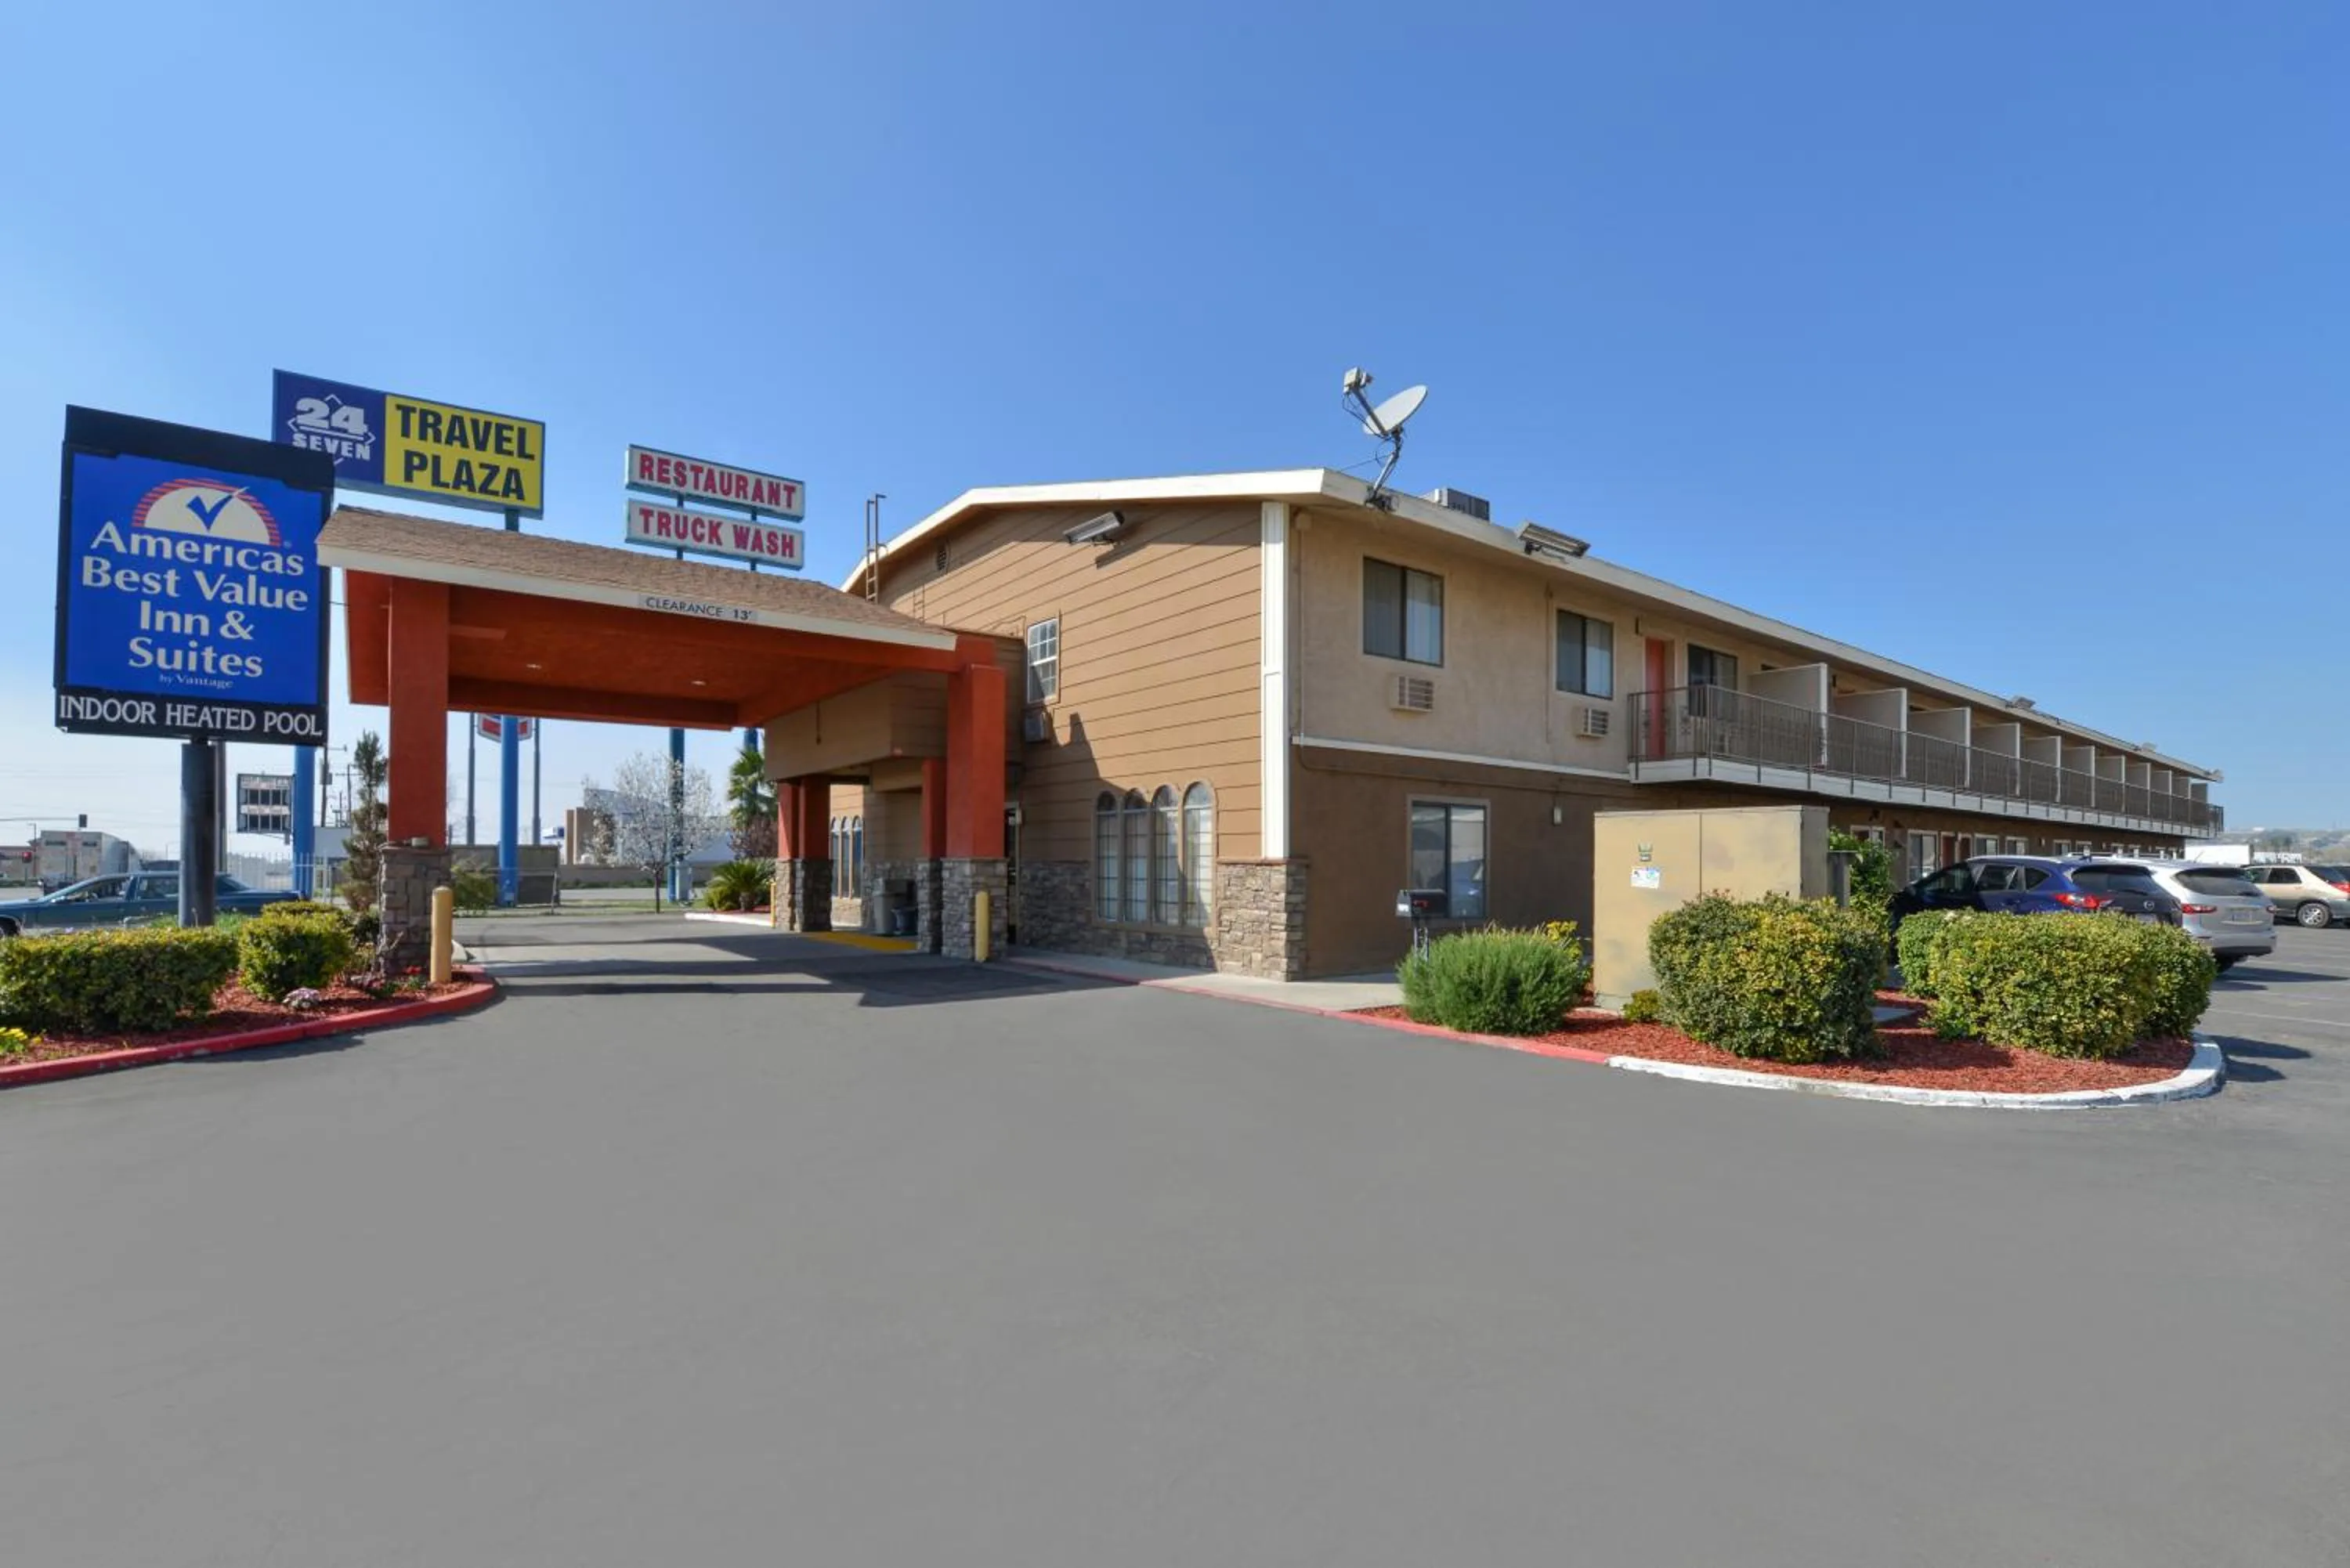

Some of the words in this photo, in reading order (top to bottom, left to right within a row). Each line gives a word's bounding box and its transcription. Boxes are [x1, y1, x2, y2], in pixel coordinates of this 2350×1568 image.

[295, 397, 368, 435] 24
[396, 403, 535, 461] TRAVEL
[292, 432, 371, 461] SEVEN
[403, 450, 525, 500] PLAZA
[639, 453, 796, 509] RESTAURANT
[90, 520, 304, 576] Americas
[639, 508, 723, 546] TRUCK
[732, 524, 794, 558] WASH
[82, 555, 181, 598] Best
[193, 569, 308, 611] Value
[140, 600, 210, 637] Inn
[219, 610, 255, 640] &
[645, 597, 724, 617] CLEARANCE
[128, 636, 263, 677] Suites
[159, 674, 172, 687] by
[175, 674, 233, 689] Vantage
[60, 695, 156, 724] INDOOR
[165, 703, 255, 731] HEATED
[263, 711, 323, 736] POOL
